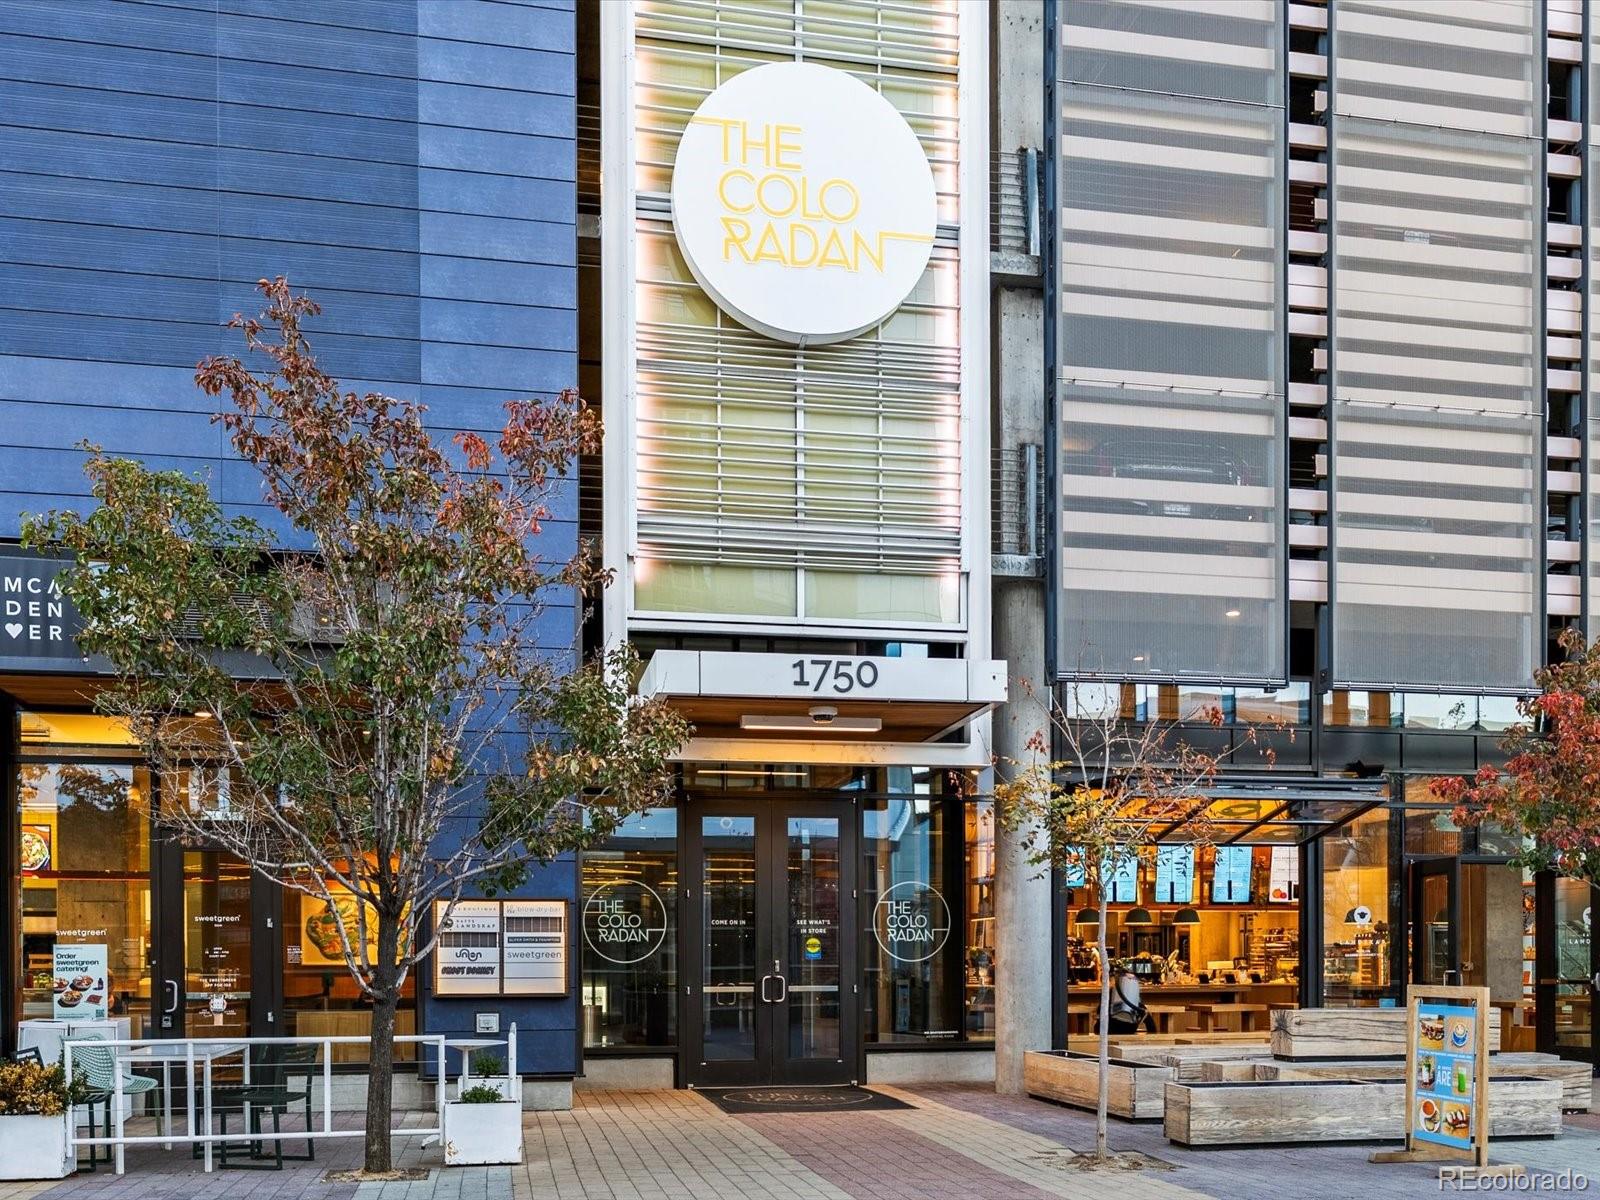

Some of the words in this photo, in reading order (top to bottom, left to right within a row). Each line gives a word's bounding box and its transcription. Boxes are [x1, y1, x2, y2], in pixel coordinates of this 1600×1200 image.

[714, 118, 802, 170] THE
[717, 168, 861, 223] COLO
[720, 216, 888, 272] RADAN
[6, 600, 63, 618] DEN
[792, 659, 879, 693] 1750
[595, 900, 624, 914] THE
[886, 901, 911, 914] THE
[597, 914, 642, 928] COLO
[886, 914, 927, 928] COLO
[598, 928, 650, 942] RADAN
[887, 928, 935, 942] RADAN
[56, 952, 77, 960] Order
[507, 951, 561, 959] sweetgreen
